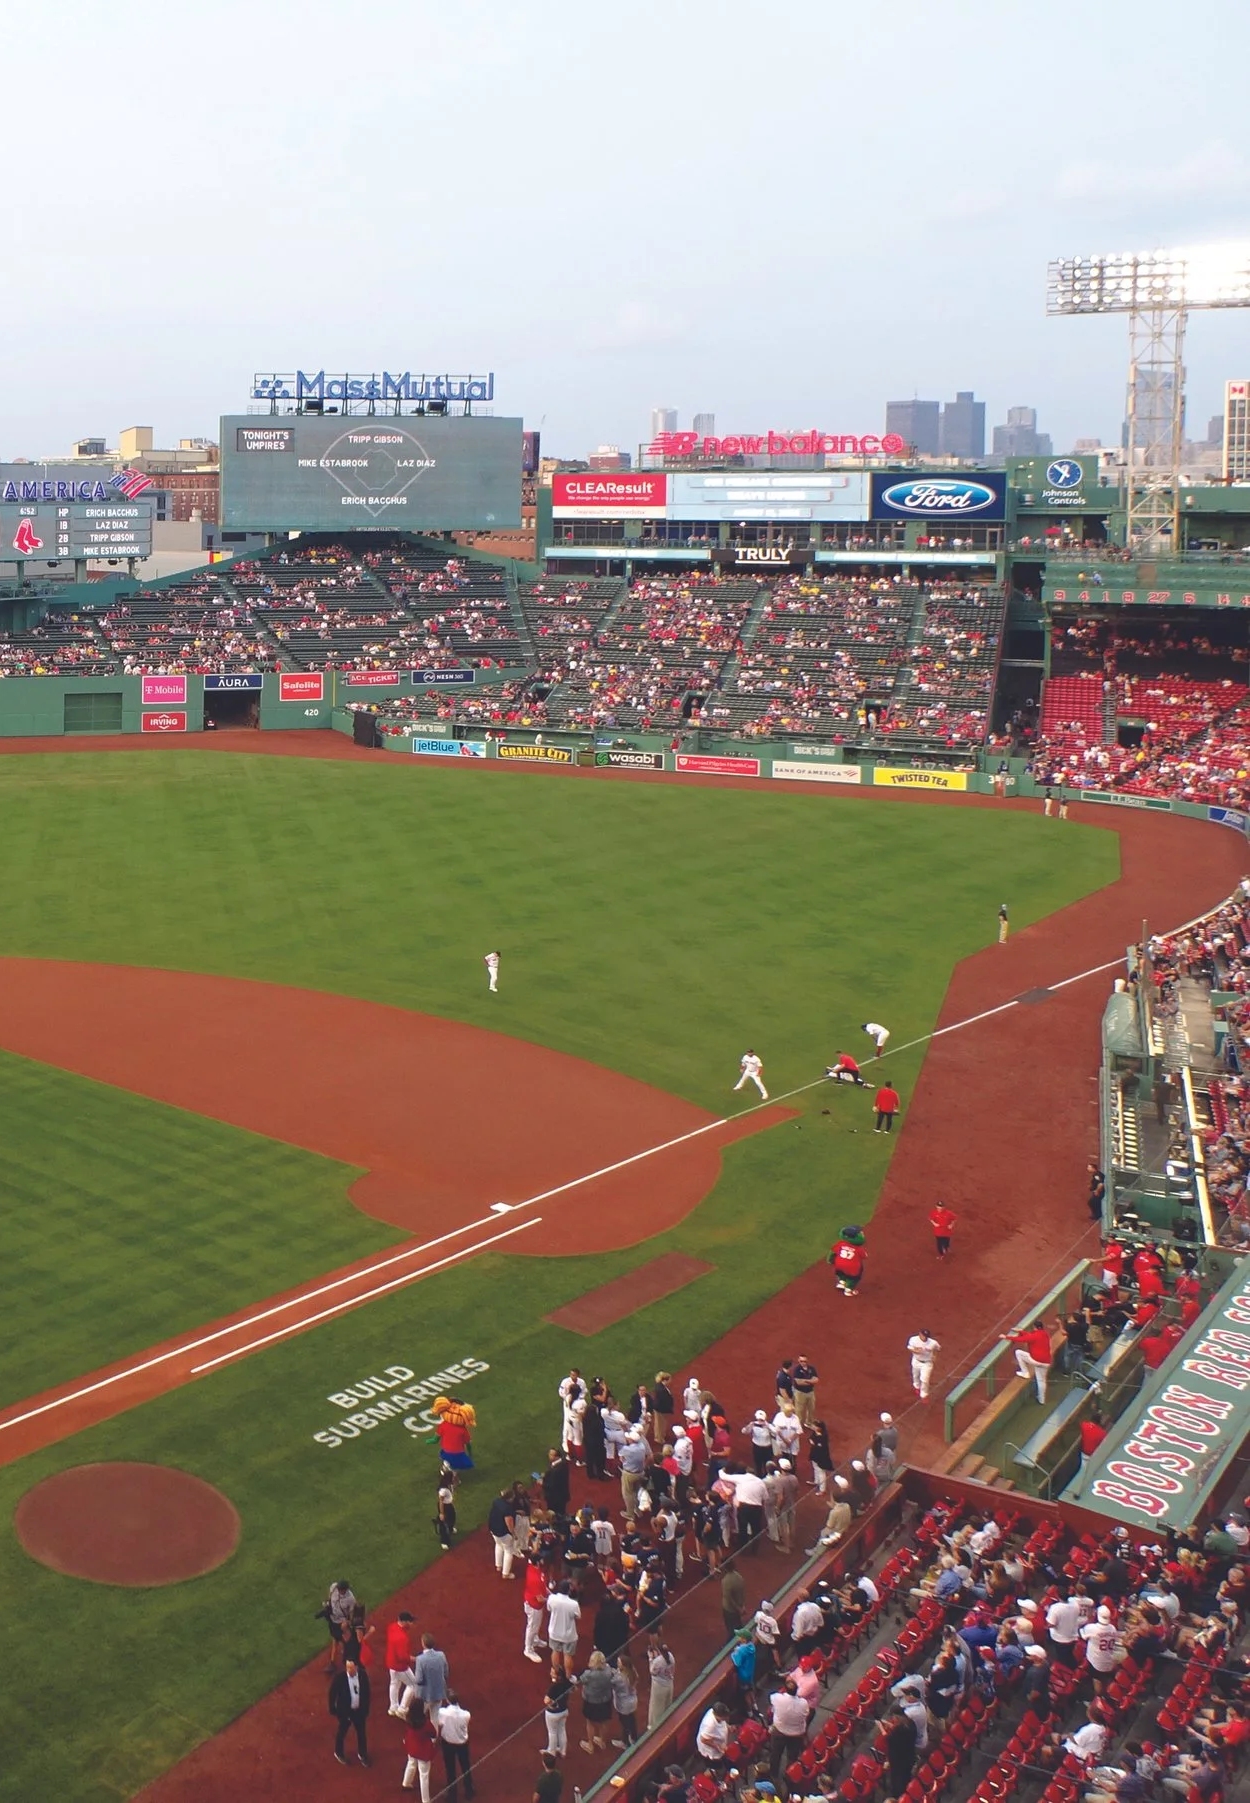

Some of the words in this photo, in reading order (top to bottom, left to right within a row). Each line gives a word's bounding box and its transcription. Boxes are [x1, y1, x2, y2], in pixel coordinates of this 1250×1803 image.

[297, 370, 494, 400] MassMutual
[243, 431, 289, 440] TONIGHT'S
[348, 435, 371, 444] TRIPP
[373, 435, 403, 444] GIBSON
[246, 441, 285, 450] UMPIRES
[703, 435, 765, 455] new
[767, 430, 904, 454] balance
[298, 459, 317, 468] MIKE
[319, 459, 369, 468] ESTABROOK
[397, 459, 415, 468] LAZ
[416, 459, 436, 468] DIAZ
[3, 480, 107, 499] AMERICA
[566, 482, 653, 494] CLEAResult
[904, 484, 974, 508] Ford
[1042, 489, 1079, 498] Johnson
[341, 496, 366, 505] ERICH
[368, 496, 407, 505] BACCHUS
[1048, 495, 1086, 505] Controls
[20, 506, 35, 515] 6:52
[58, 508, 69, 518] HP
[85, 508, 106, 517] ERICH
[107, 508, 138, 517] BACCHUS
[59, 521, 68, 530] 1B
[95, 521, 111, 530] LAZ
[112, 521, 129, 530] DIAZ
[58, 534, 69, 543] 2B
[89, 533, 108, 542] TRIPP
[109, 533, 135, 542] GIBSON
[58, 547, 69, 556] 3B
[83, 546, 100, 555] MIKE
[101, 545, 140, 555] ESTABROOK
[735, 548, 790, 560] TRULY
[1054, 590, 1066, 601] 9
[1078, 590, 1089, 601] 4
[1102, 591, 1110, 602] 1
[1147, 591, 1171, 603] 27
[368, 674, 397, 684] TICKET
[155, 686, 184, 694] Mobile
[283, 682, 320, 690] Safelite
[417, 740, 454, 752] jetBlue
[499, 747, 546, 757] GRANITE
[547, 747, 571, 761] CITY
[609, 754, 655, 764] wasabi
[891, 774, 930, 784] TWISTED
[932, 777, 949, 787] TEA
[327, 1365, 415, 1409] BUILD
[313, 1357, 490, 1449] SUBMARINES
[403, 1409, 444, 1438] .CO
[1092, 1385, 1234, 1518] BOSTON
